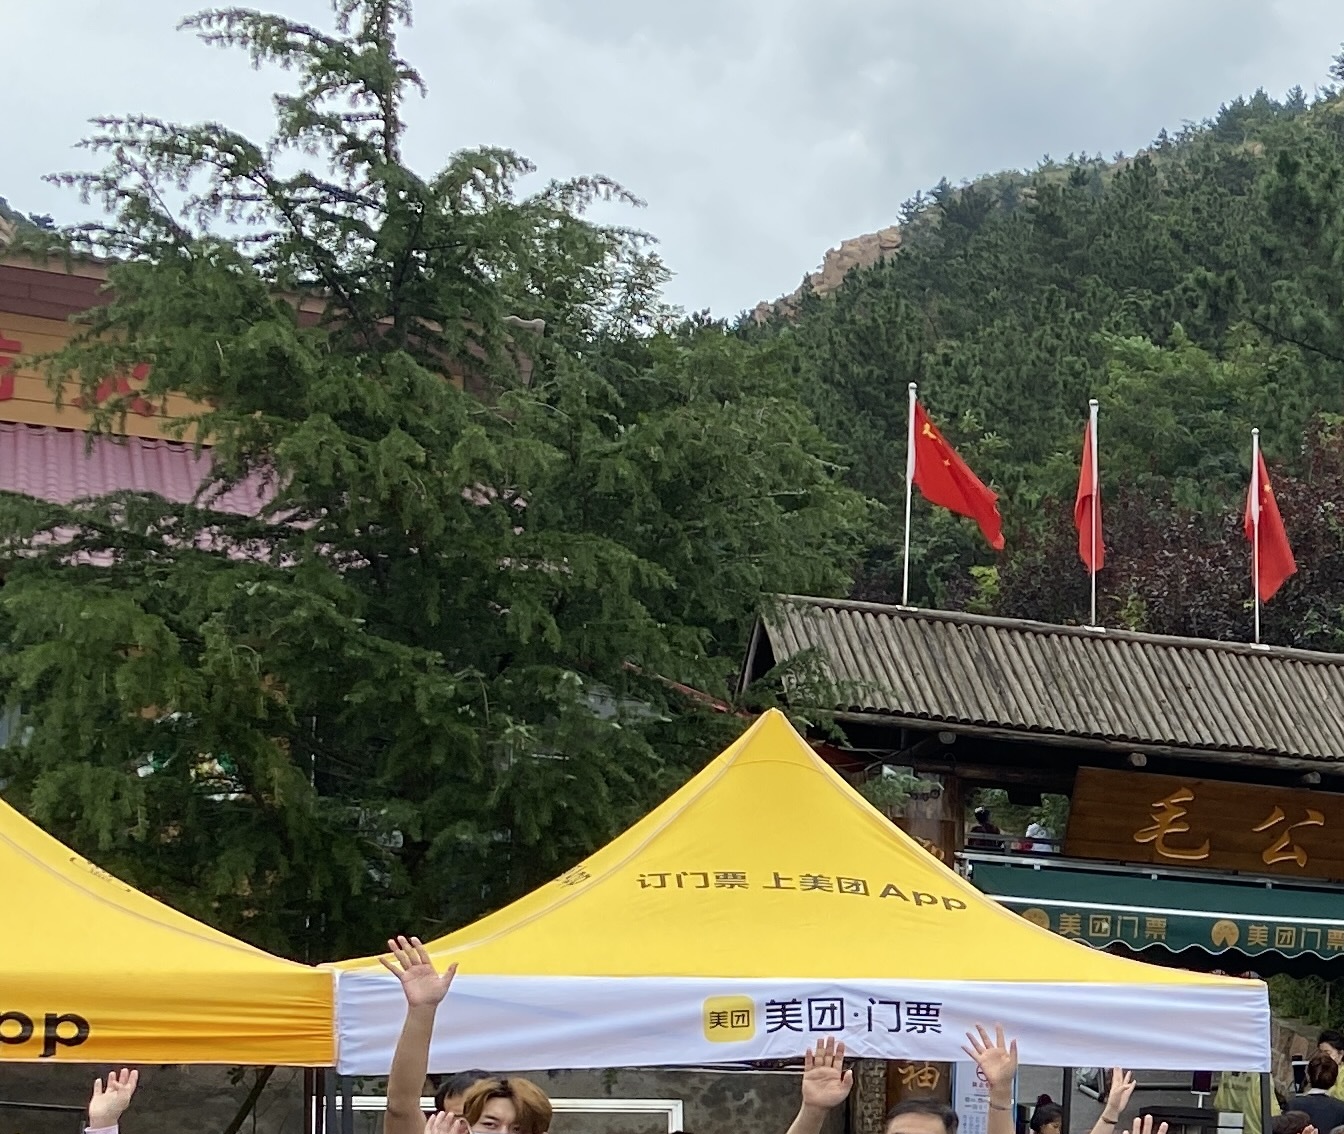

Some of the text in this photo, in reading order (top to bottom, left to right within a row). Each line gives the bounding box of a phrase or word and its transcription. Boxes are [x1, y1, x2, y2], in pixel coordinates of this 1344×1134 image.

[636, 871, 968, 911] 订门票 上美团 App
[1059, 912, 1168, 940] 美团门票
[708, 1010, 751, 1029] 美团
